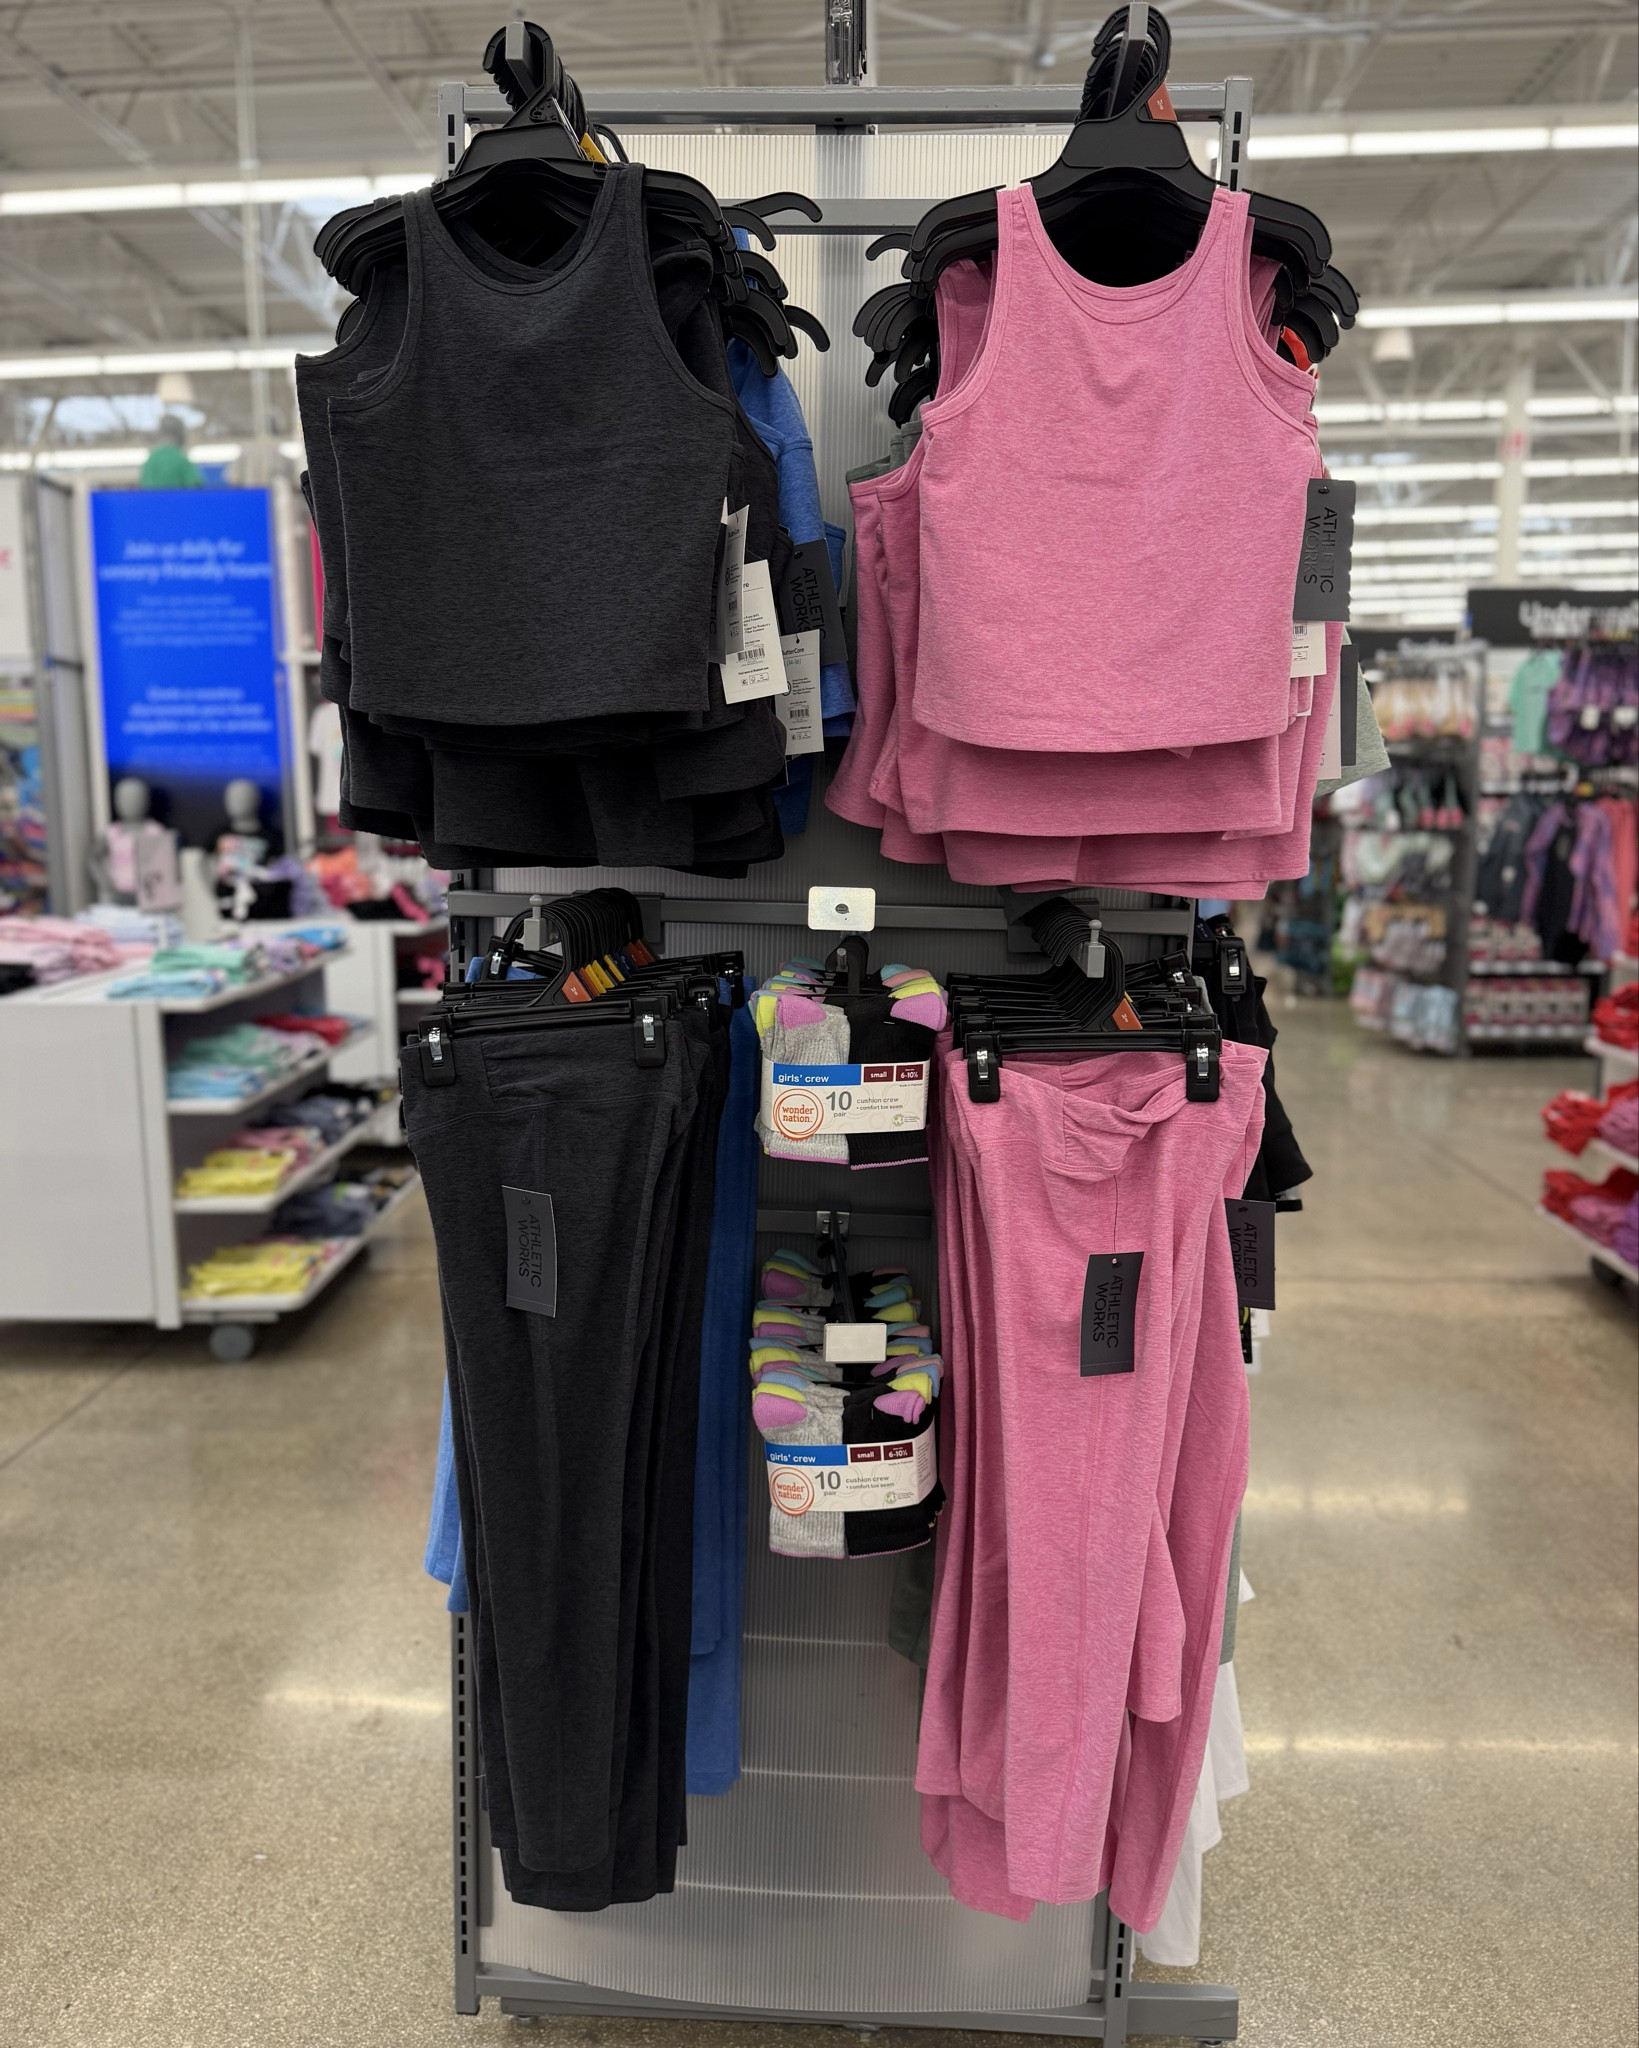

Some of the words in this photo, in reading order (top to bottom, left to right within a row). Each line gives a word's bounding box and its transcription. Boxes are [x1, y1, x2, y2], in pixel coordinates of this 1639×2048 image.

[1304, 516, 1321, 584] WORKS
[778, 1074, 802, 1083] girls'
[805, 1075, 829, 1083] crew
[870, 1071, 887, 1079] small
[782, 1104, 814, 1114] wonder
[826, 1091, 852, 1111] 10
[518, 1220, 529, 1277] WORKS
[529, 1213, 542, 1288] ATHLETIC
[1244, 1222, 1257, 1288] ATHLETIC
[1092, 1282, 1109, 1343] WORKS
[1106, 1275, 1124, 1349] ATHLETIC
[770, 1453, 791, 1462] girls'
[793, 1455, 816, 1463] crew
[857, 1451, 875, 1459] small
[777, 1483, 805, 1492] wonder
[815, 1471, 841, 1490] 10
